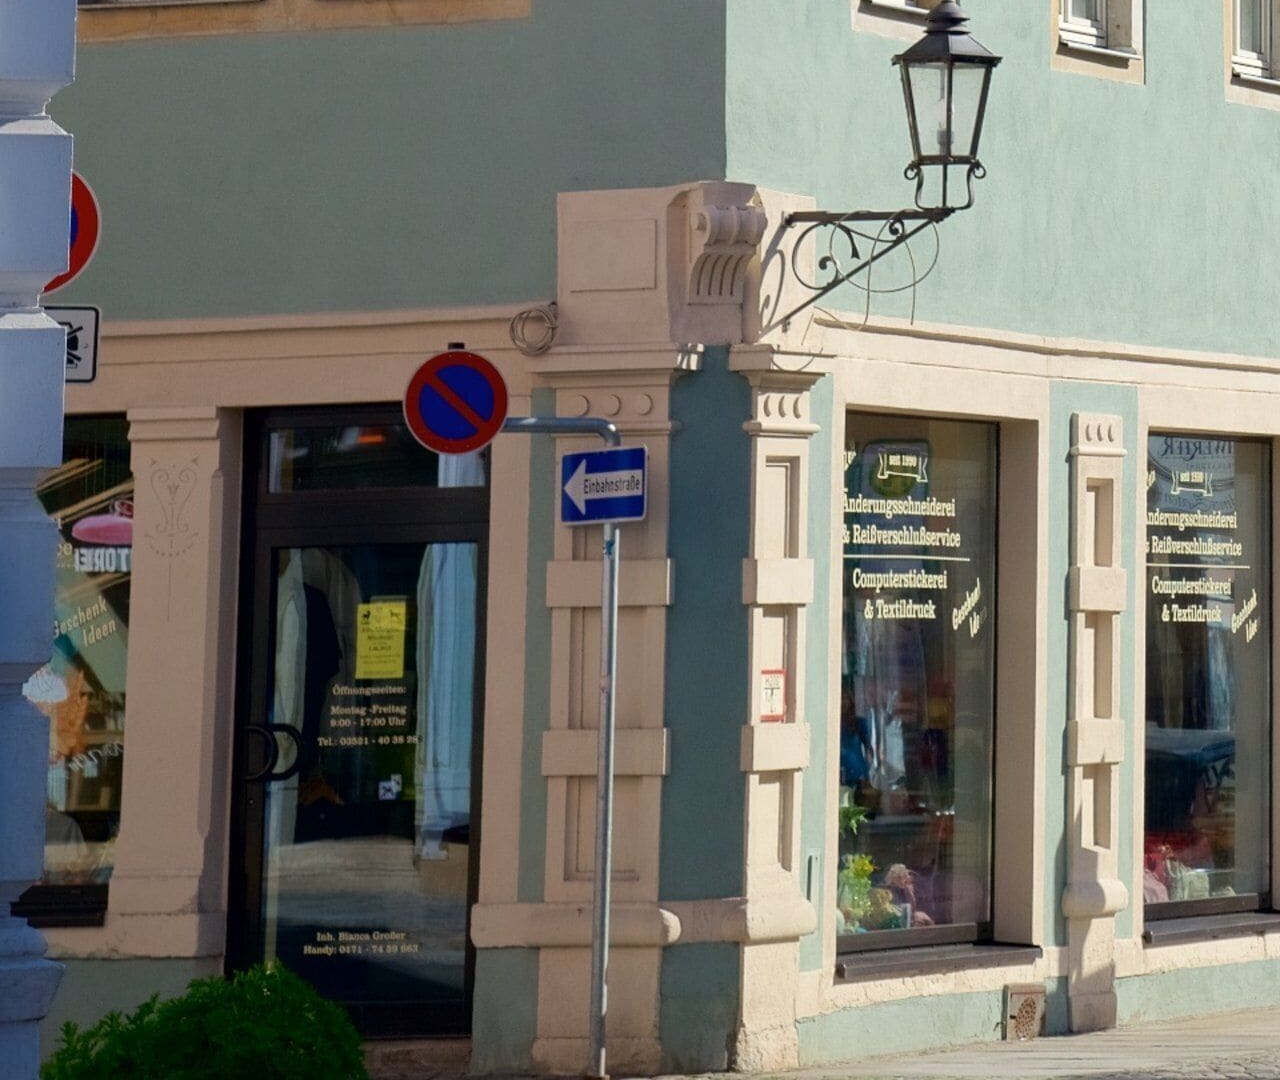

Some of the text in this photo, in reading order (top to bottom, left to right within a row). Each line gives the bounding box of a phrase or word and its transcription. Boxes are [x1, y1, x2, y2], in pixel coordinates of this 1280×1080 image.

[584, 475, 640, 495] Einbahnstraße
[843, 488, 956, 519] Änderungsschneiderei
[1147, 508, 1238, 531] nderungsschneiderei
[853, 524, 961, 547] Reißverschlußservice
[1152, 536, 1242, 556] Reißverschlußservice
[853, 568, 948, 593] Computerstickerei
[1152, 576, 1232, 599] Computerstickerei
[864, 599, 936, 619] & Textildruck
[1162, 604, 1222, 622] & Textildruck
[330, 705, 366, 716] Montag
[388, 717, 406, 726] Uhr
